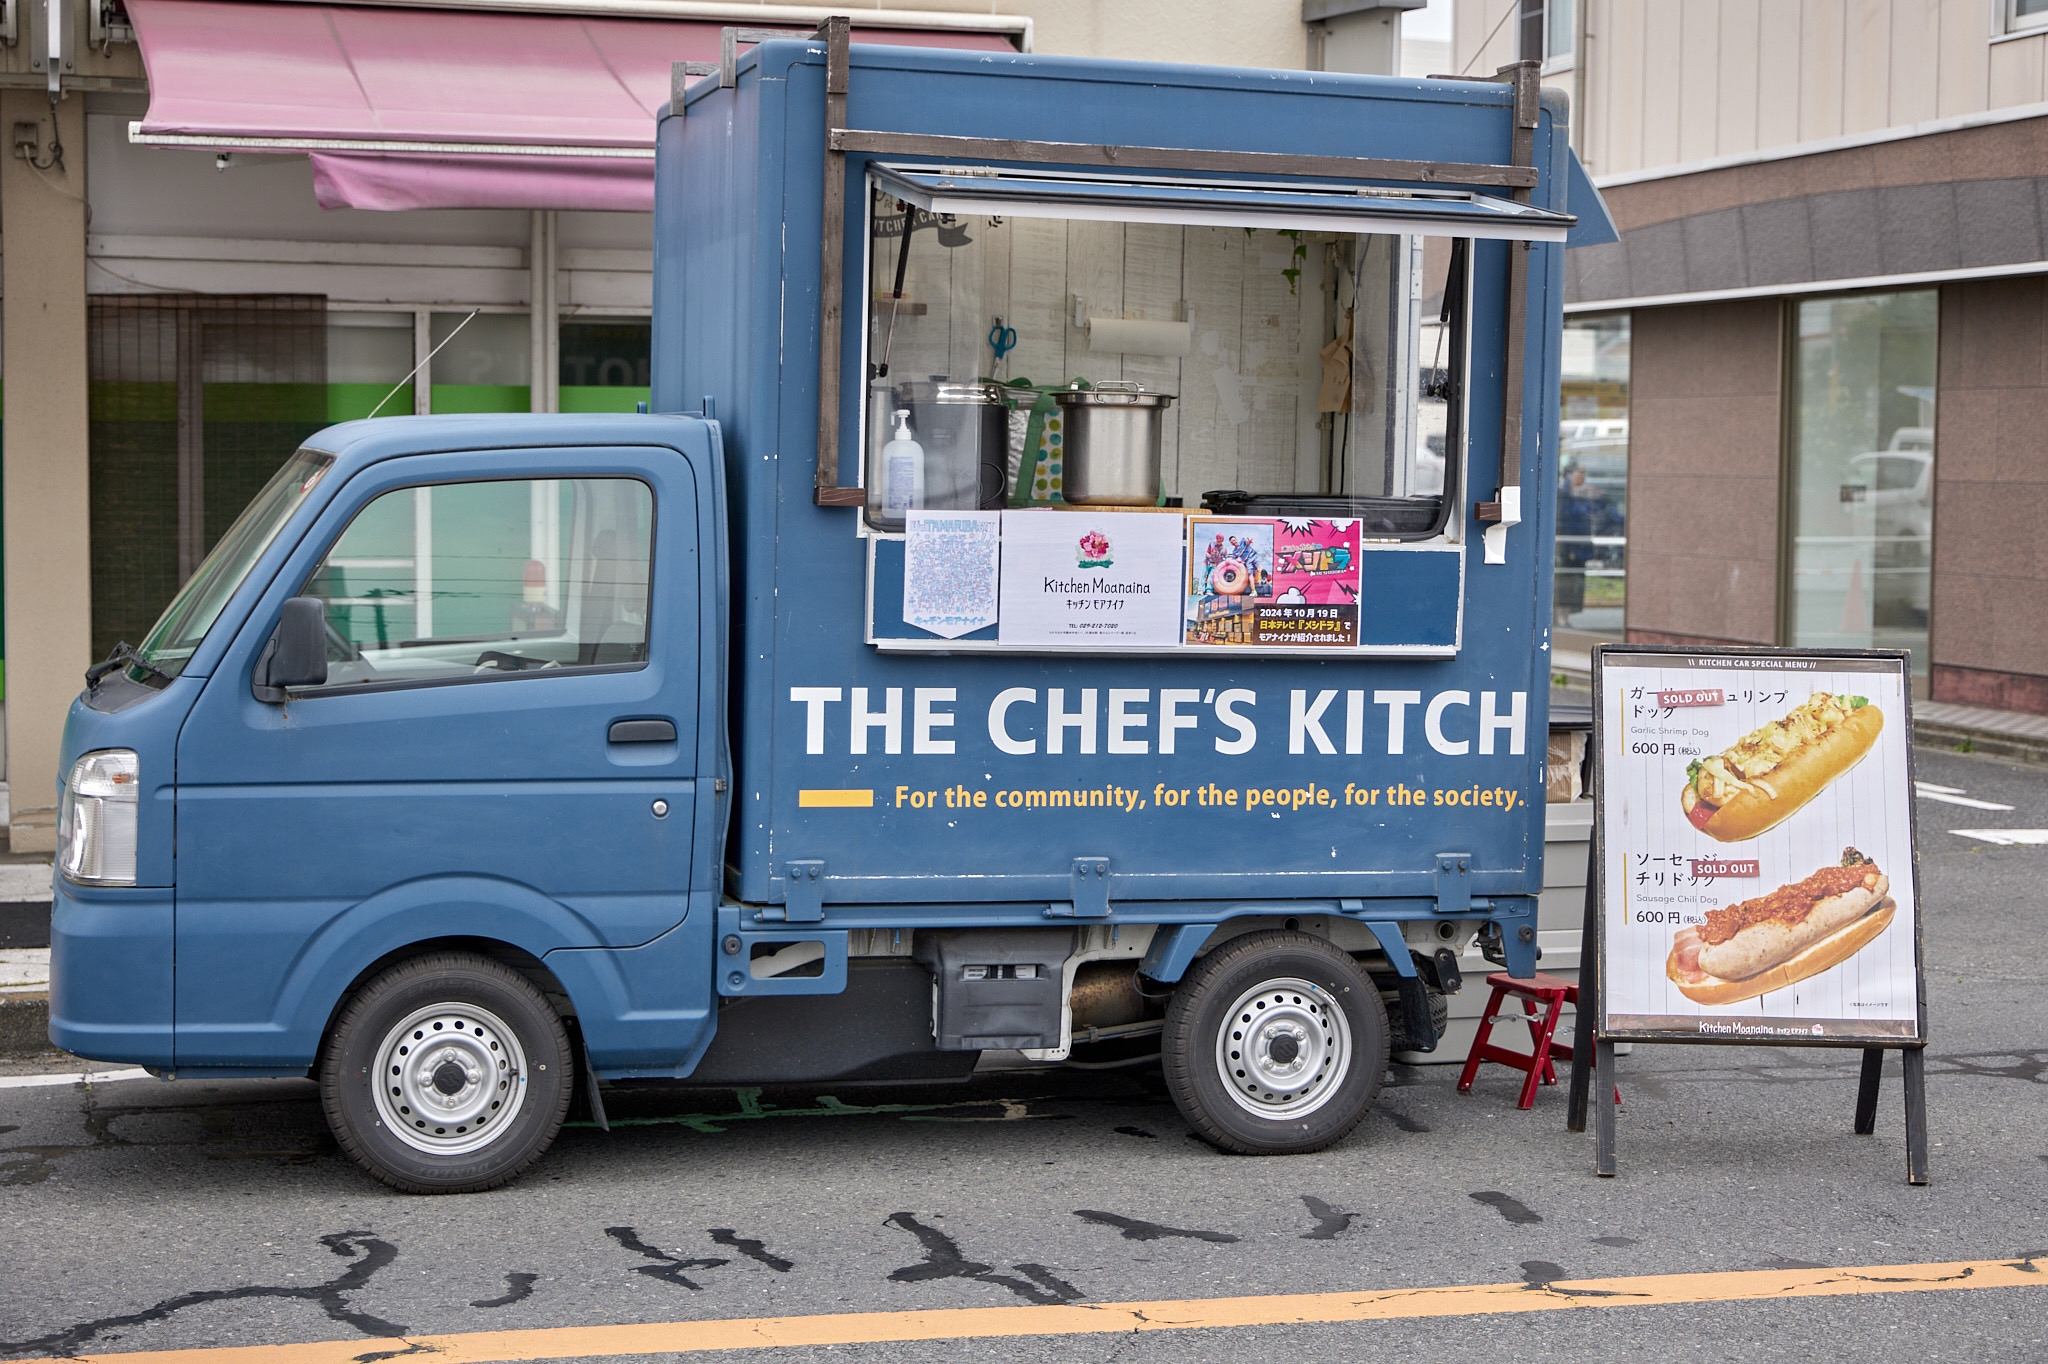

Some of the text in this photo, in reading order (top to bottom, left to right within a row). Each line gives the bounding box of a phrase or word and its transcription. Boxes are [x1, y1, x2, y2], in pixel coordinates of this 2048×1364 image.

[1282, 548, 1351, 573] メシドラ
[1044, 576, 1151, 594] Kitchen Moanaina
[1698, 658, 1808, 669] KITCHEN CAR SPECIAL MENU
[1663, 692, 1719, 704] SOLD OUT
[791, 687, 1526, 755] THE CHEF'S KITCH
[1630, 726, 1709, 738] Garlic Shrimp Dog
[896, 783, 1524, 811] For the community, for the people, for the society.
[1697, 863, 1755, 874] SOLD OUT
[1636, 894, 1718, 906] Sausage Chili Dog
[1699, 1021, 1732, 1034] Kitchen
[1732, 1022, 1774, 1035] Moanaina
